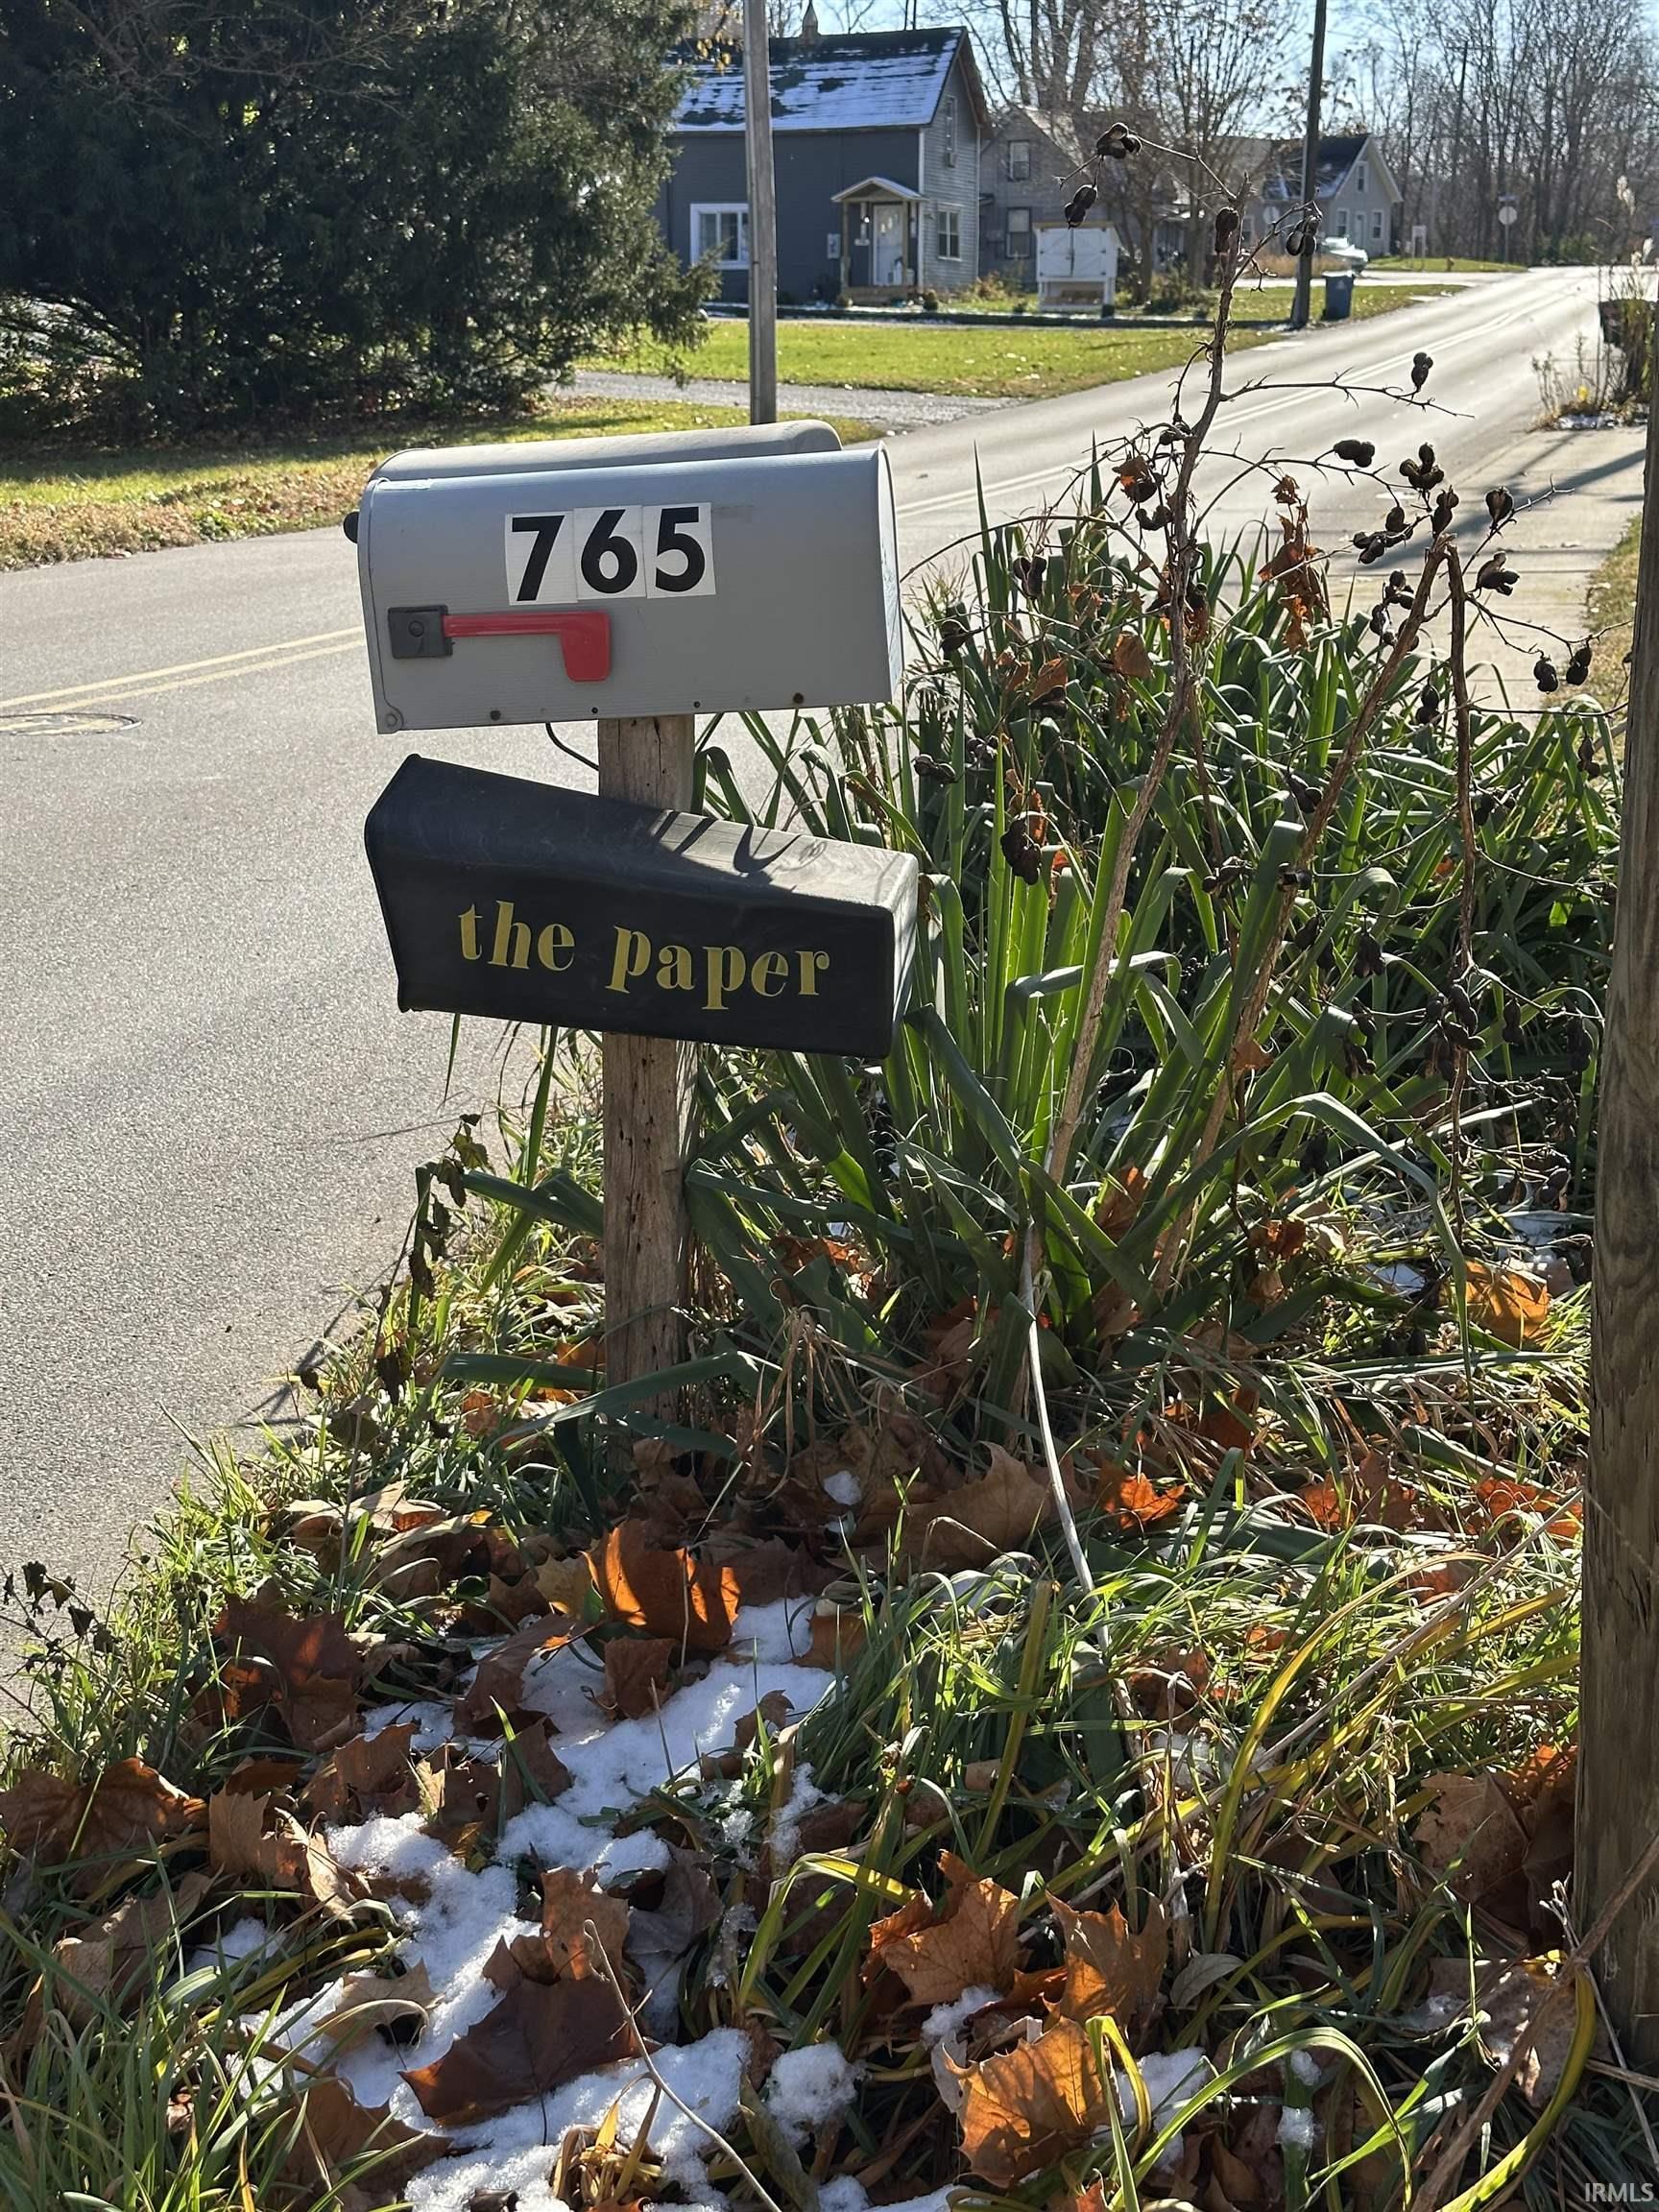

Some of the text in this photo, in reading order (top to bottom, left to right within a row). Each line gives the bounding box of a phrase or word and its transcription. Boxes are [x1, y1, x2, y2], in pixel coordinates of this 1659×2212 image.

[512, 507, 706, 601] 765
[458, 900, 830, 1010] the paper
